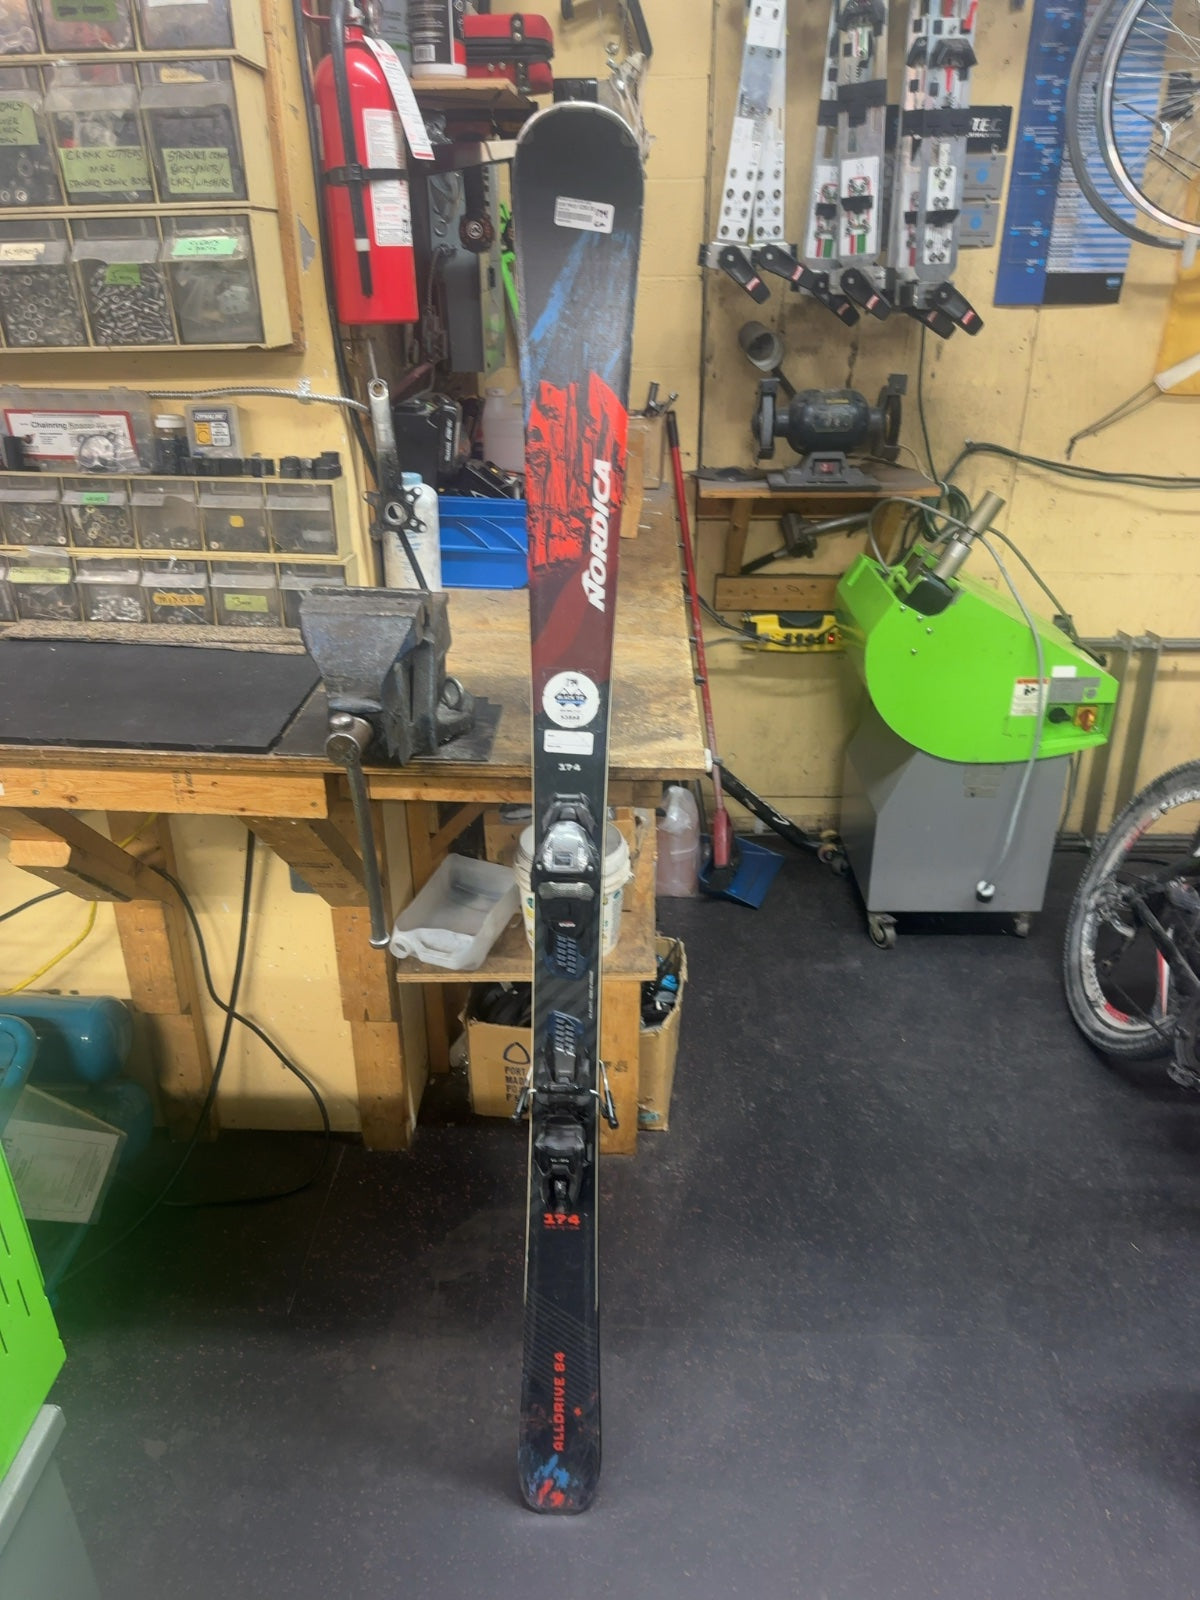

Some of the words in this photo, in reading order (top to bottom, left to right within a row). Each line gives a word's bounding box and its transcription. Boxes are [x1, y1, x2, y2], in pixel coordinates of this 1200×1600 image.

[31, 421, 67, 430] Chainring
[581, 458, 612, 612] NORDICA
[558, 763, 581, 771] 174
[505, 1076, 527, 1085] MAD
[543, 1214, 581, 1225] 174
[554, 1352, 565, 1372] 84
[553, 1377, 565, 1452] ALLDRIVE
